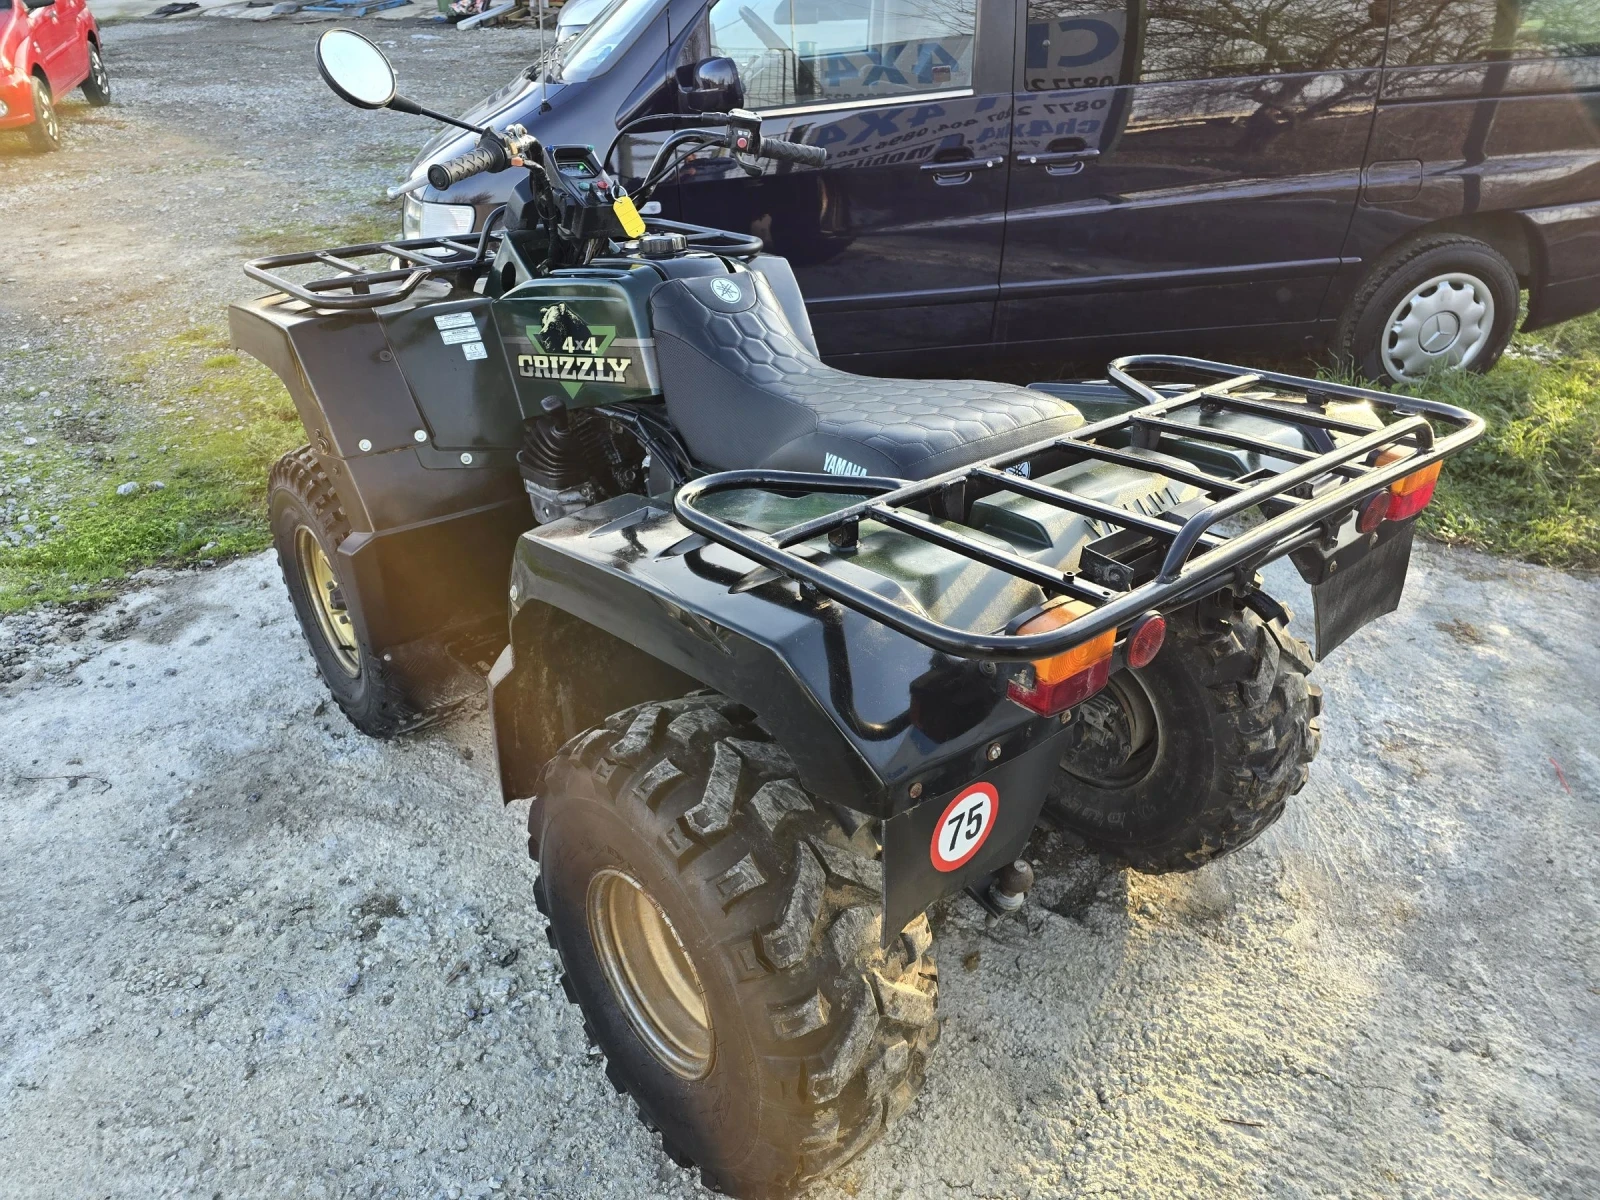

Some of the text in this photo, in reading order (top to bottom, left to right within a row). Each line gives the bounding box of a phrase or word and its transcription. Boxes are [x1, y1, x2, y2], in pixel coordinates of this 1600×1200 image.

[518, 355, 632, 383] GRIZZLY
[823, 451, 868, 477] YAMAHA
[947, 800, 984, 852] 75
